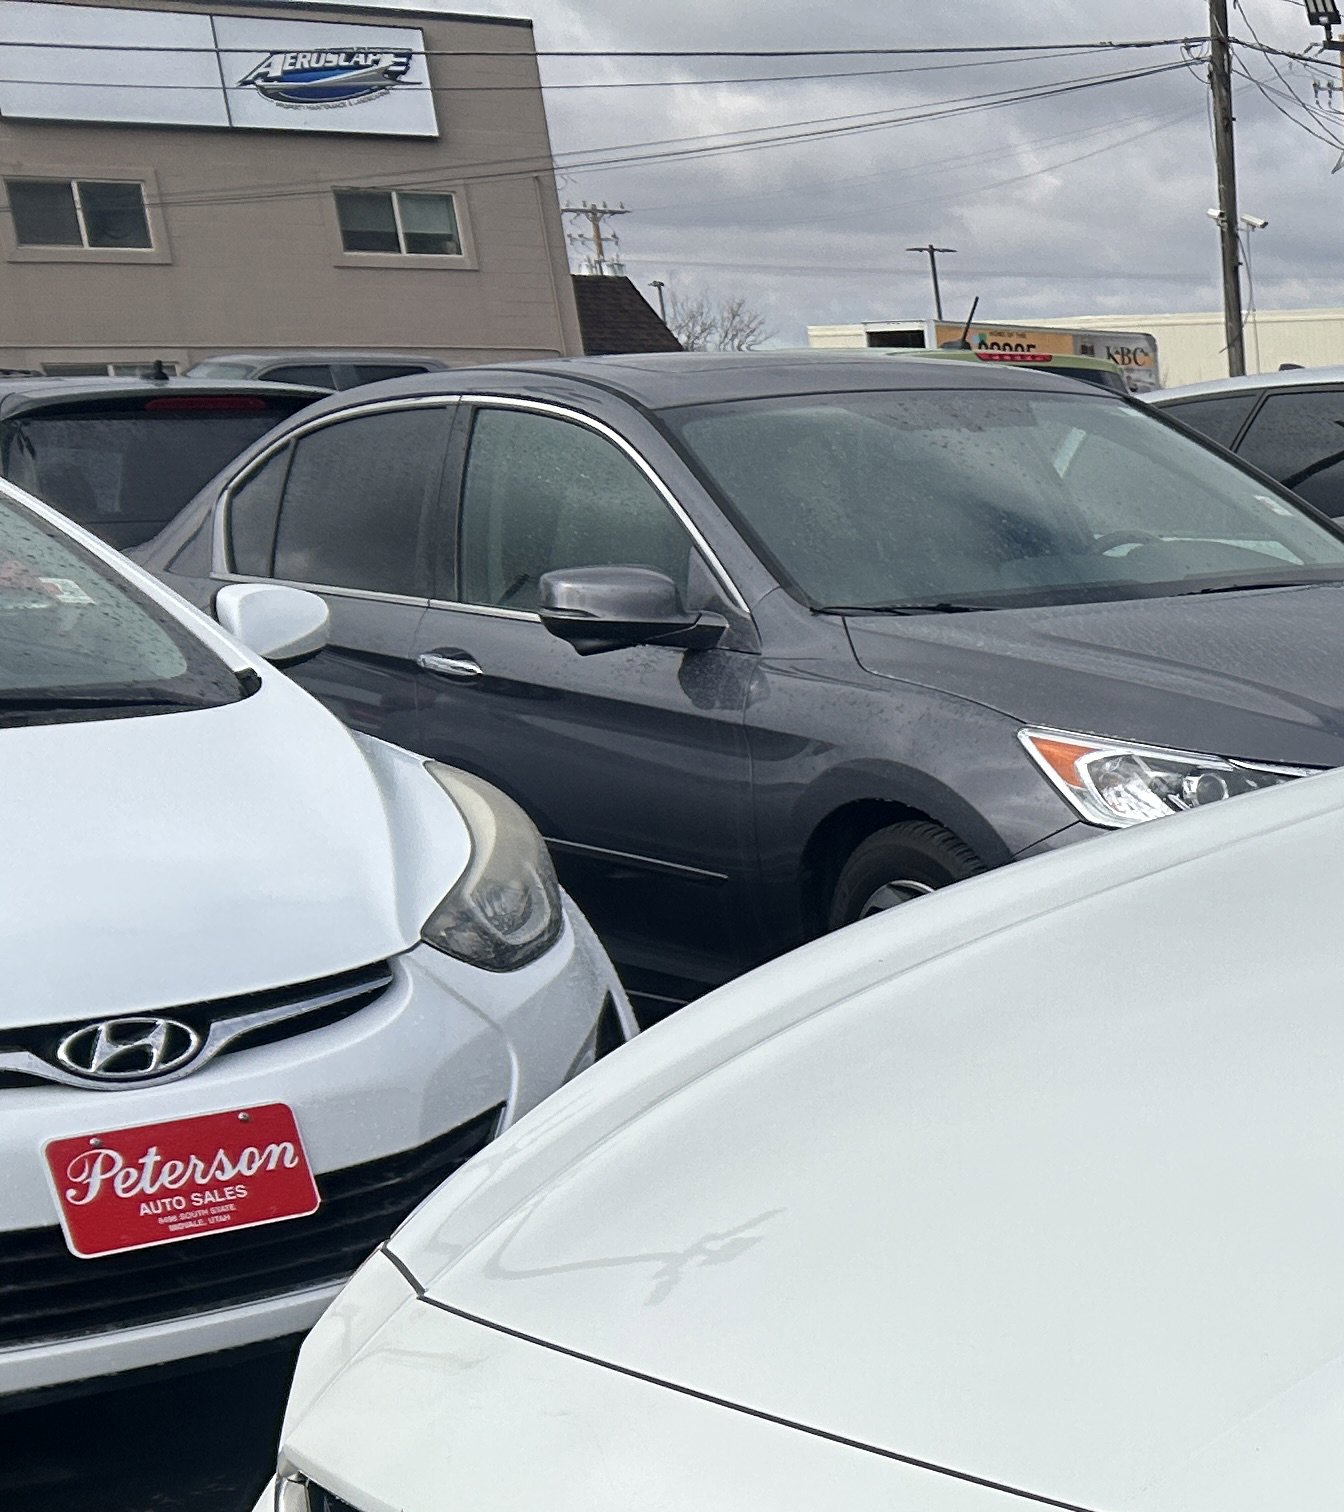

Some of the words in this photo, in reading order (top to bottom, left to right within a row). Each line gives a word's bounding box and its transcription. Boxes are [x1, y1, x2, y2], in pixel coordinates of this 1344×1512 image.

[66, 1141, 299, 1206] Peterson
[139, 1195, 186, 1217] AUTO
[191, 1184, 248, 1207] SALES
[179, 1208, 208, 1221] SOUTH
[210, 1203, 236, 1215] STATE
[208, 1213, 231, 1225] UTAH
